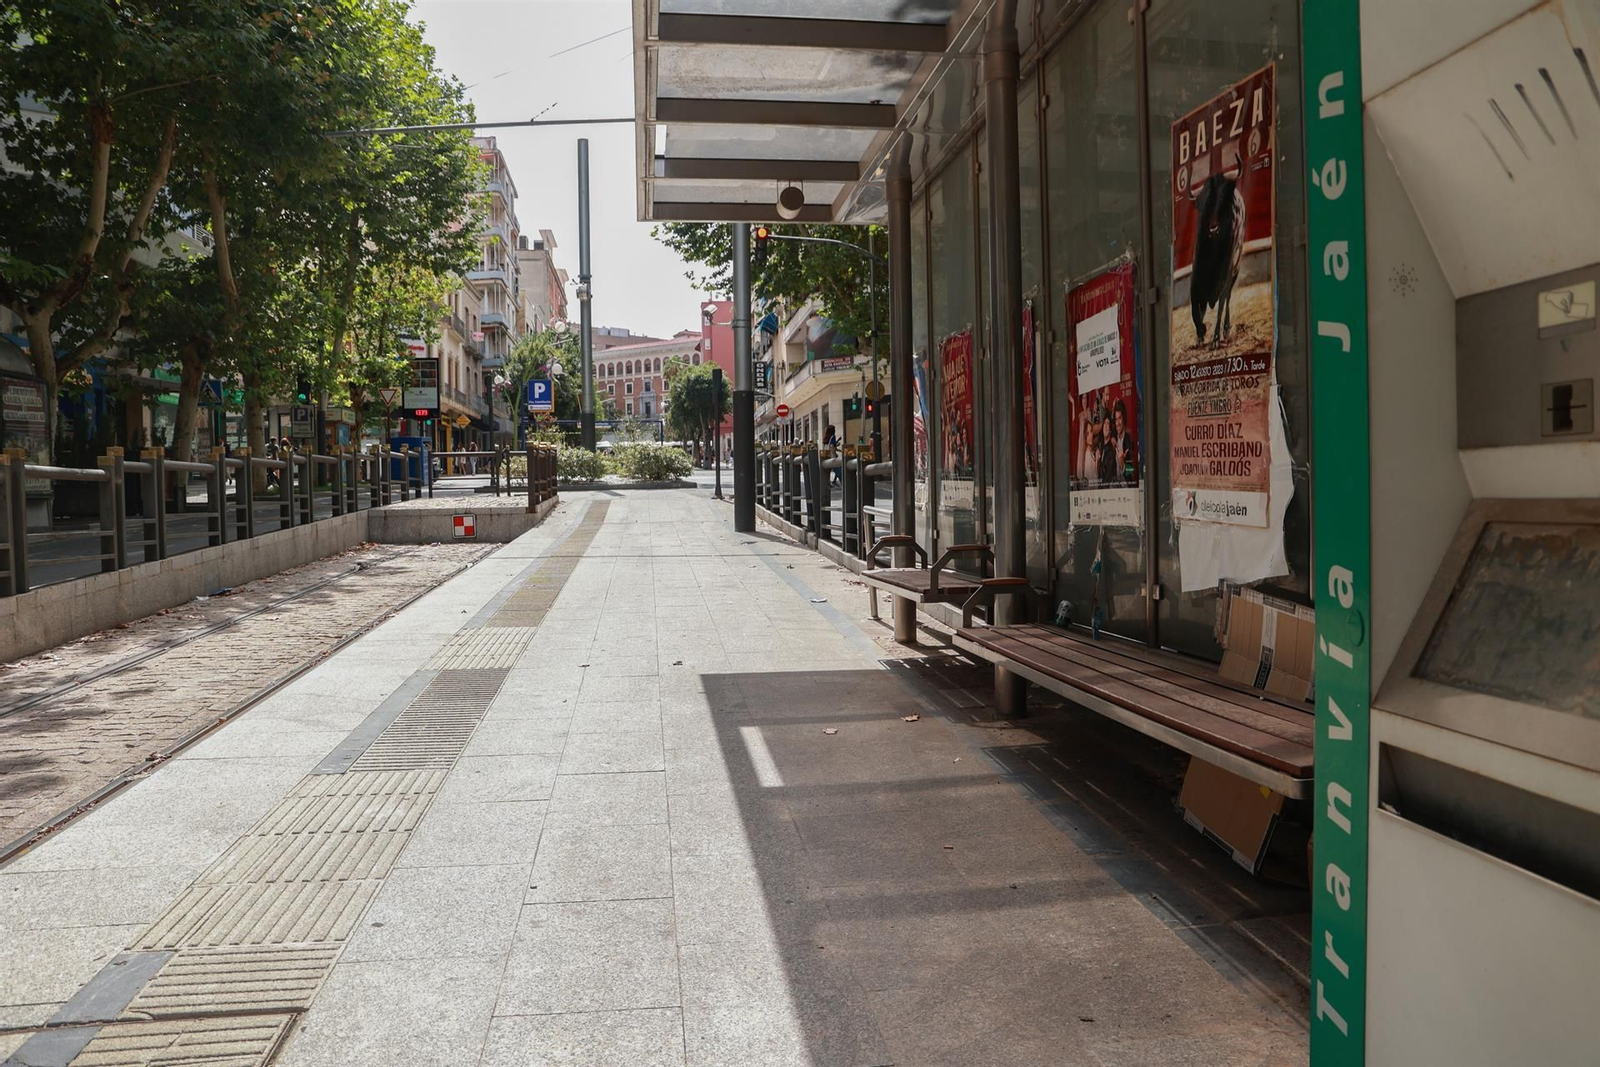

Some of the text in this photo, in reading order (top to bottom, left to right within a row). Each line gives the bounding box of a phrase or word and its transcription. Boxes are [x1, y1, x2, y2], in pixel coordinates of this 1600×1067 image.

[1179, 87, 1264, 166] BAEZA
[1095, 357, 1110, 369] VOTA
[1250, 359, 1266, 371] Tarde
[534, 382, 546, 399] P
[1193, 380, 1220, 395] CORRIDA
[1230, 375, 1260, 391] TOROS
[297, 409, 306, 420] P
[1187, 399, 1208, 415] FUENTE
[1185, 419, 1244, 441] CURRO DÍAZ
[1174, 440, 1263, 459] MANUEL ESCRIBANO
[1209, 456, 1251, 477] GALDÓS
[1312, 69, 1355, 1038] Tranvía Jaén
